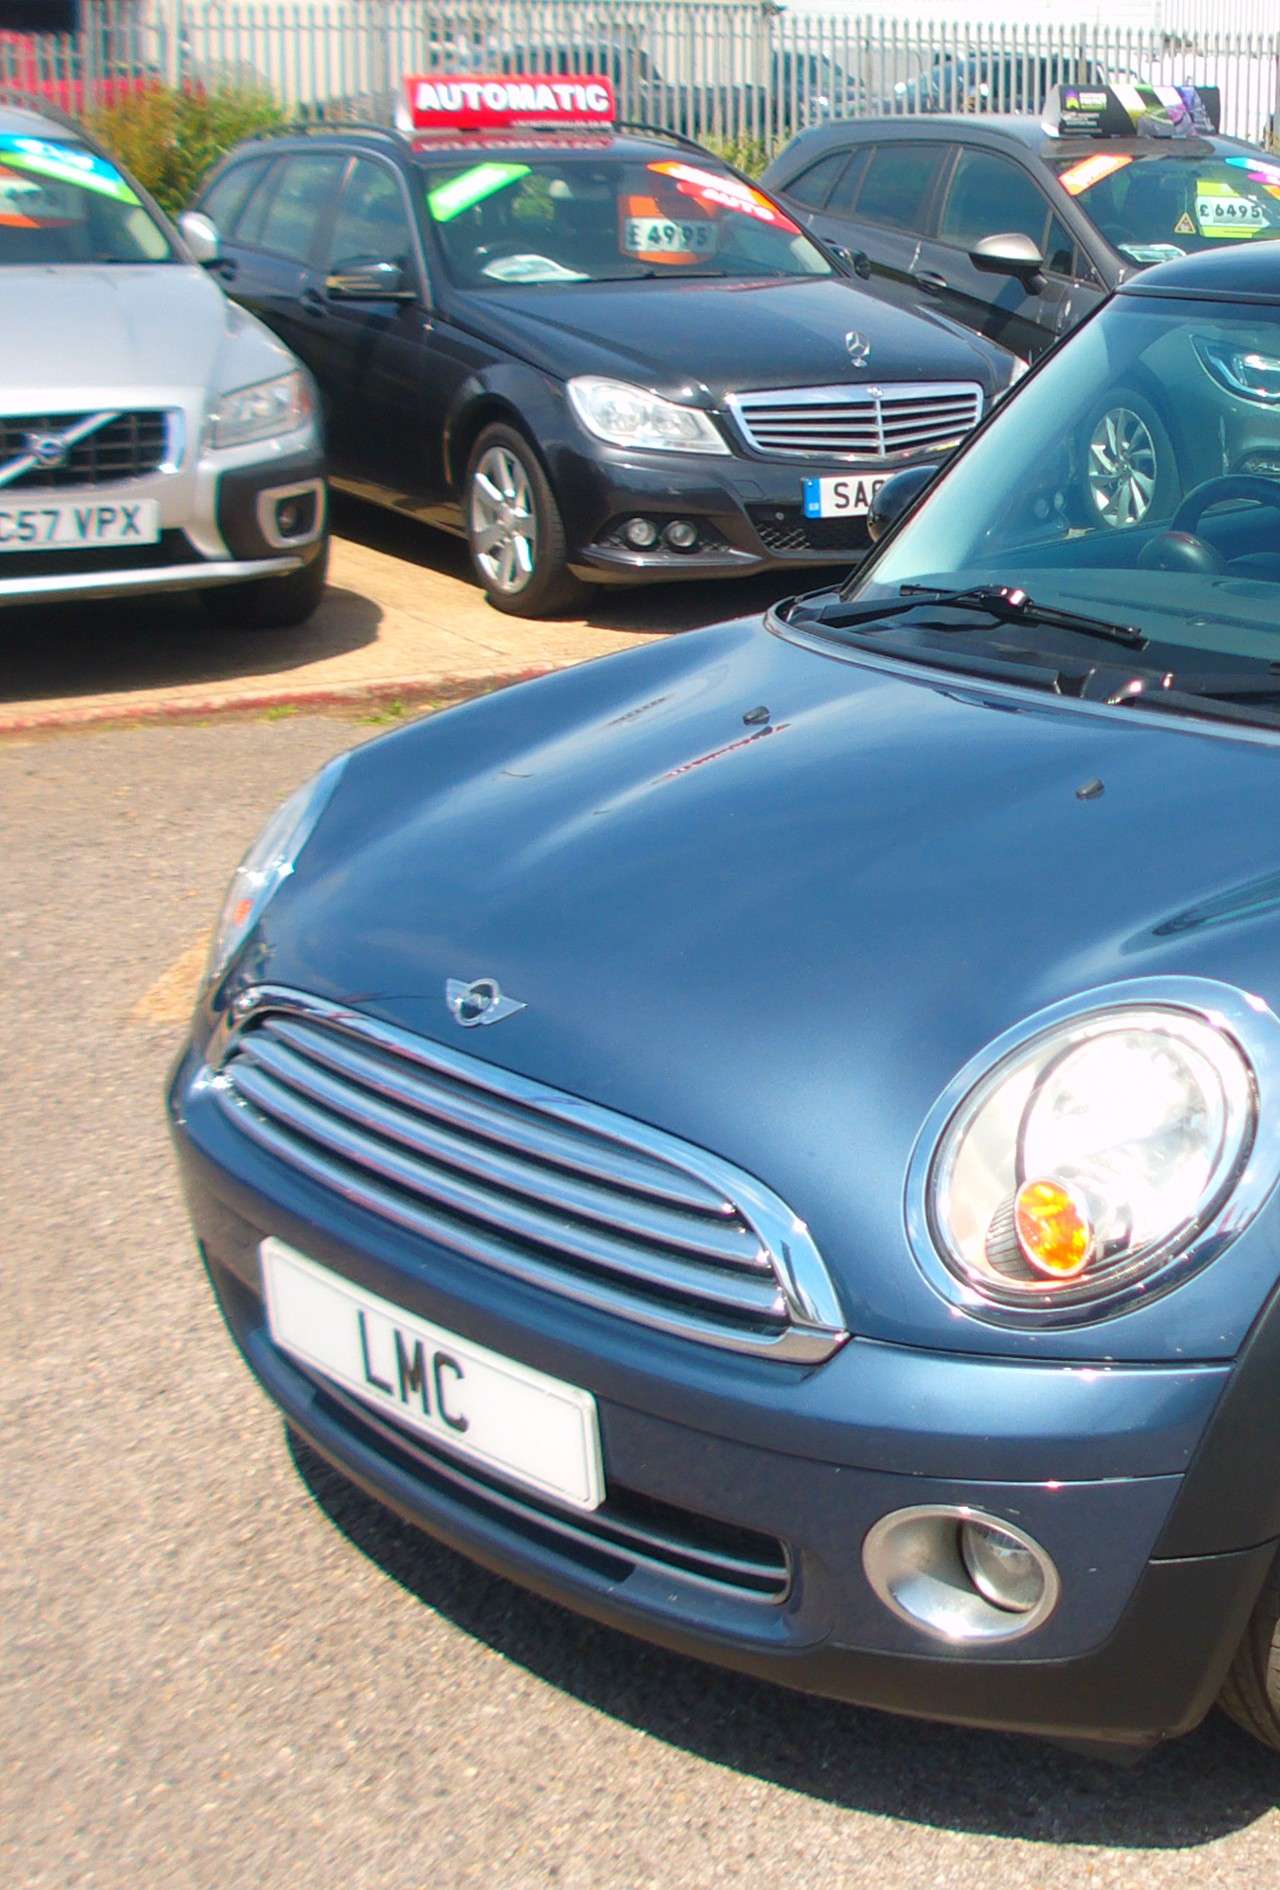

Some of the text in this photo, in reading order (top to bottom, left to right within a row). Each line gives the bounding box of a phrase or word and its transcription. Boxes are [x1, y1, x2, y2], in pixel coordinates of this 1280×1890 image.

[416, 82, 610, 111] AUTOMATIC
[74, 505, 141, 539] VPX
[358, 1310, 470, 1433] LMC
